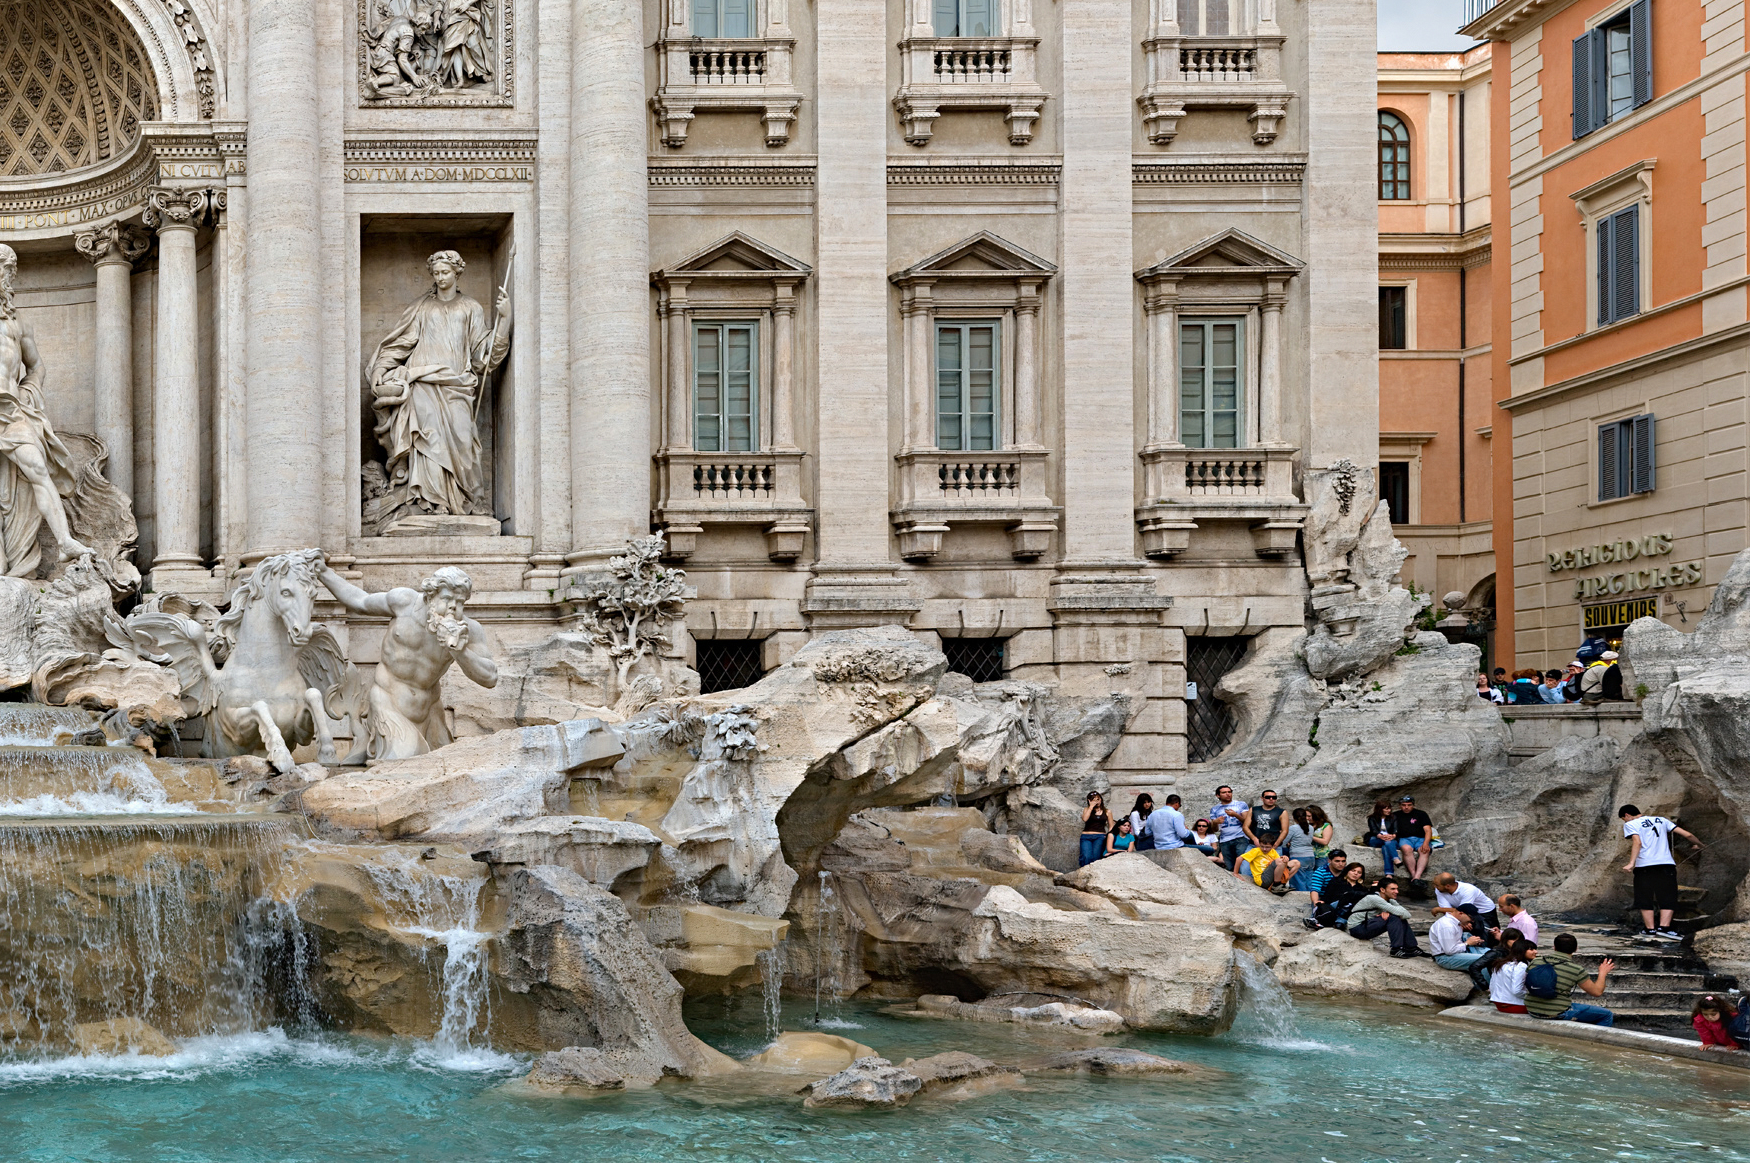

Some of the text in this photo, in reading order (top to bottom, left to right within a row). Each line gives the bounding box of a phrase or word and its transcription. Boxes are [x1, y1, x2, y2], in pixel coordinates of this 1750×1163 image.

[1547, 532, 1674, 572] RELIGIOUS
[1572, 562, 1703, 600] ARTICLES
[1585, 599, 1657, 627] SOUVENIRS
